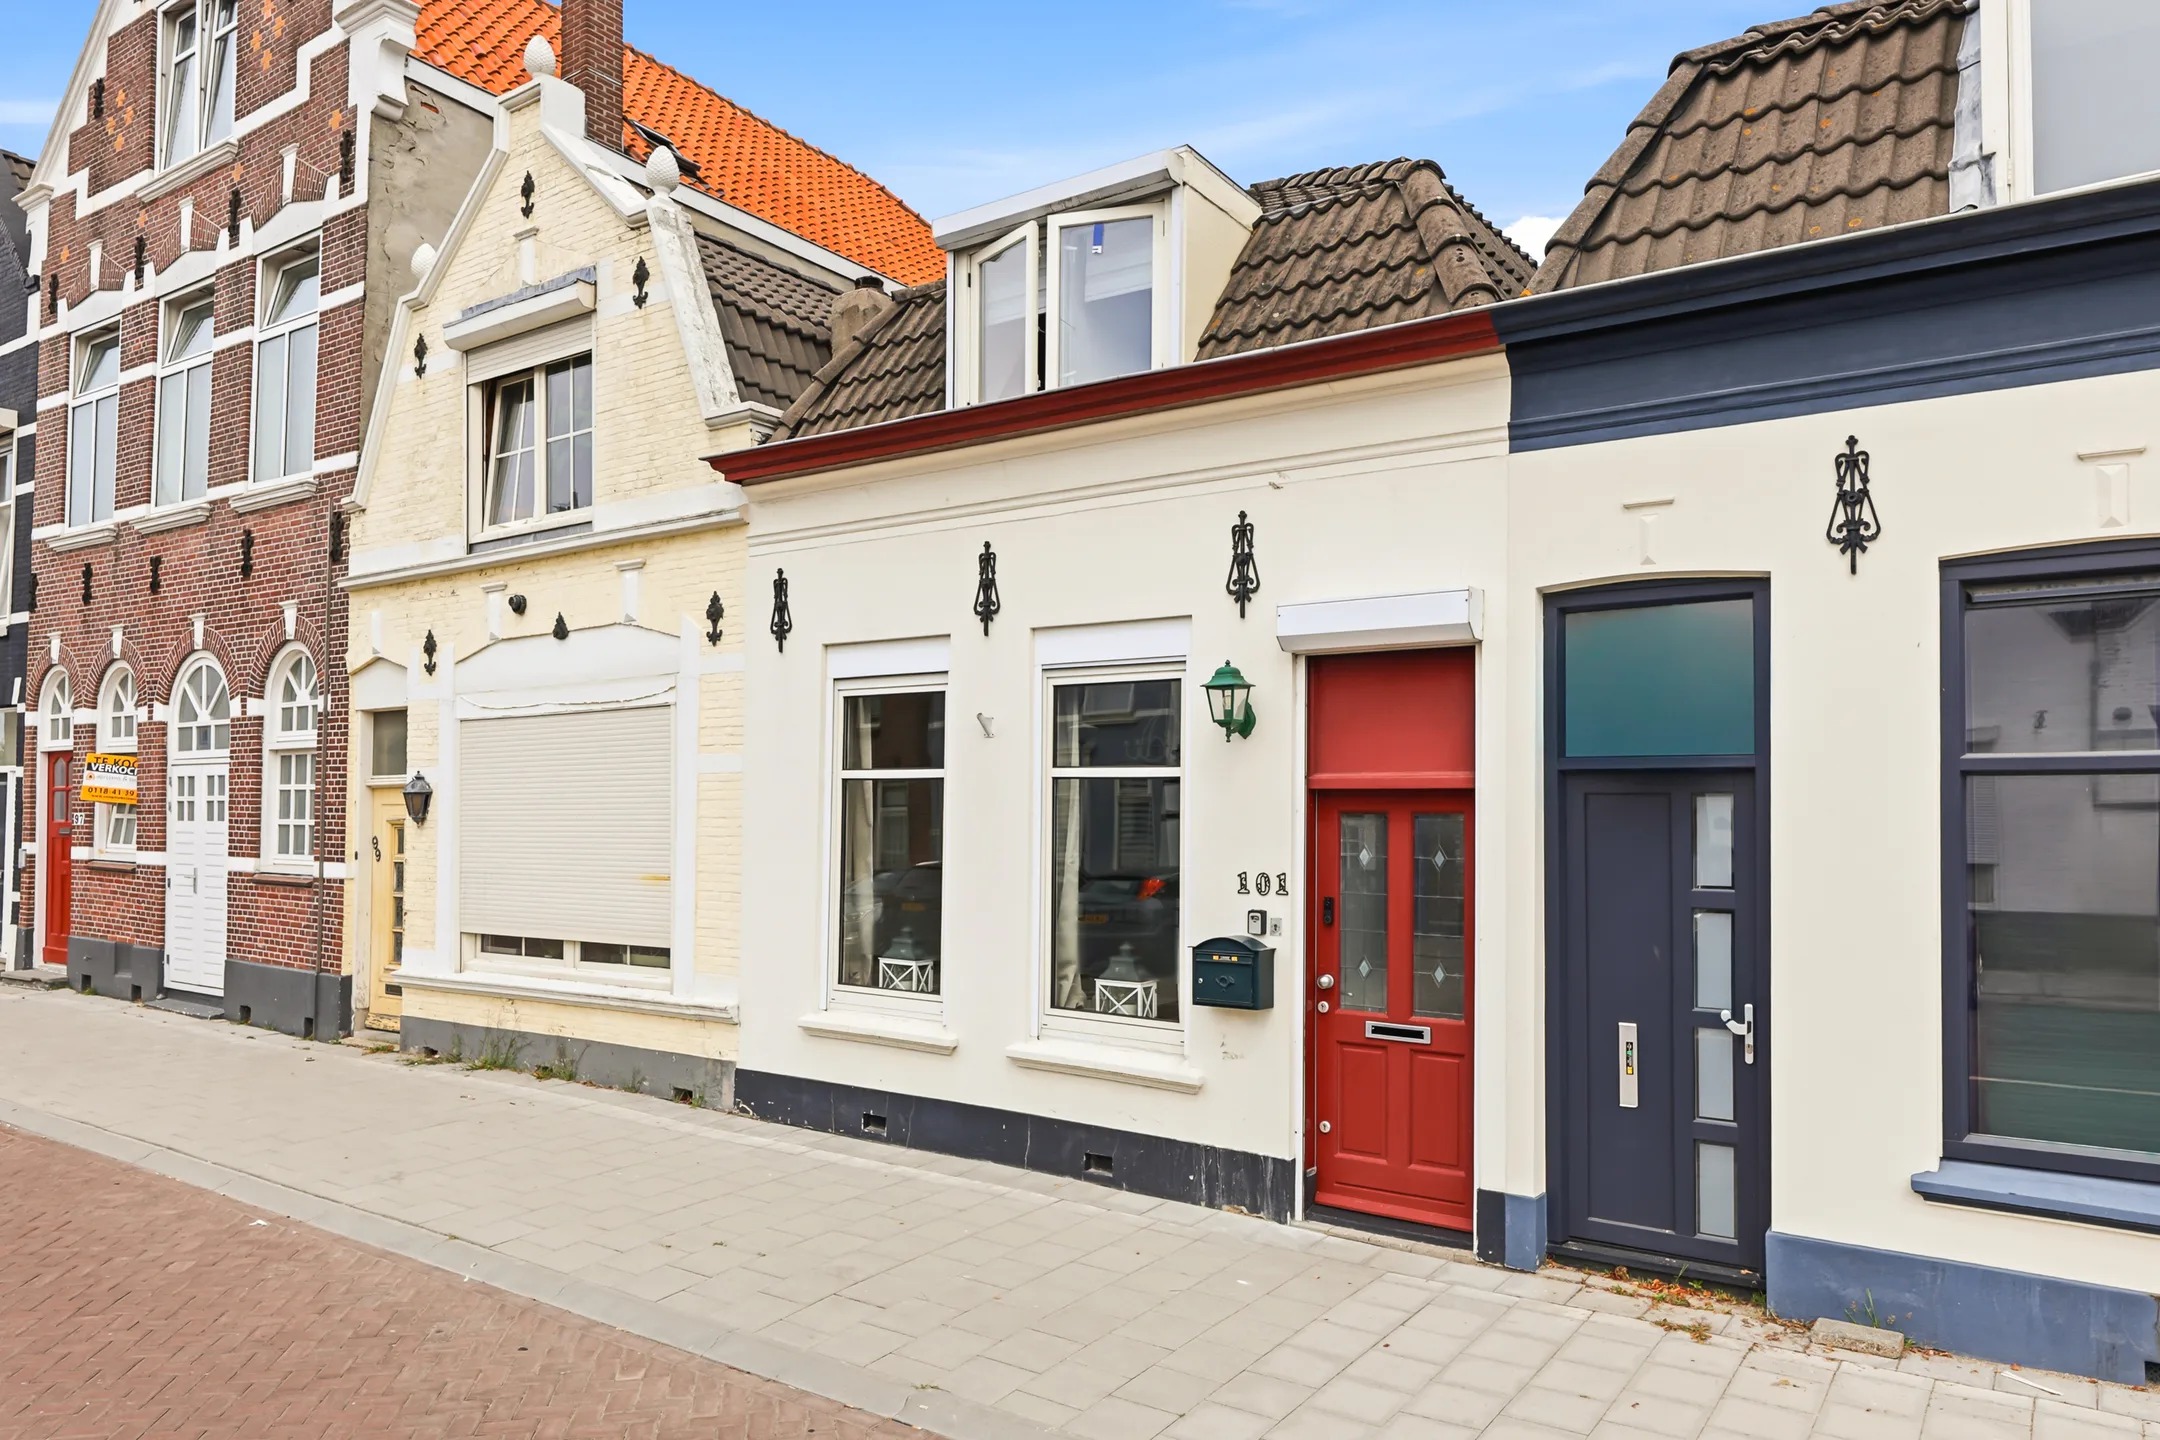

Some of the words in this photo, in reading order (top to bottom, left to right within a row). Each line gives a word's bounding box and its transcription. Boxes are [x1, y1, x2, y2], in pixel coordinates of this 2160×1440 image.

[74, 814, 84, 824] 97
[372, 836, 381, 862] 99
[1237, 871, 1289, 896] 101
